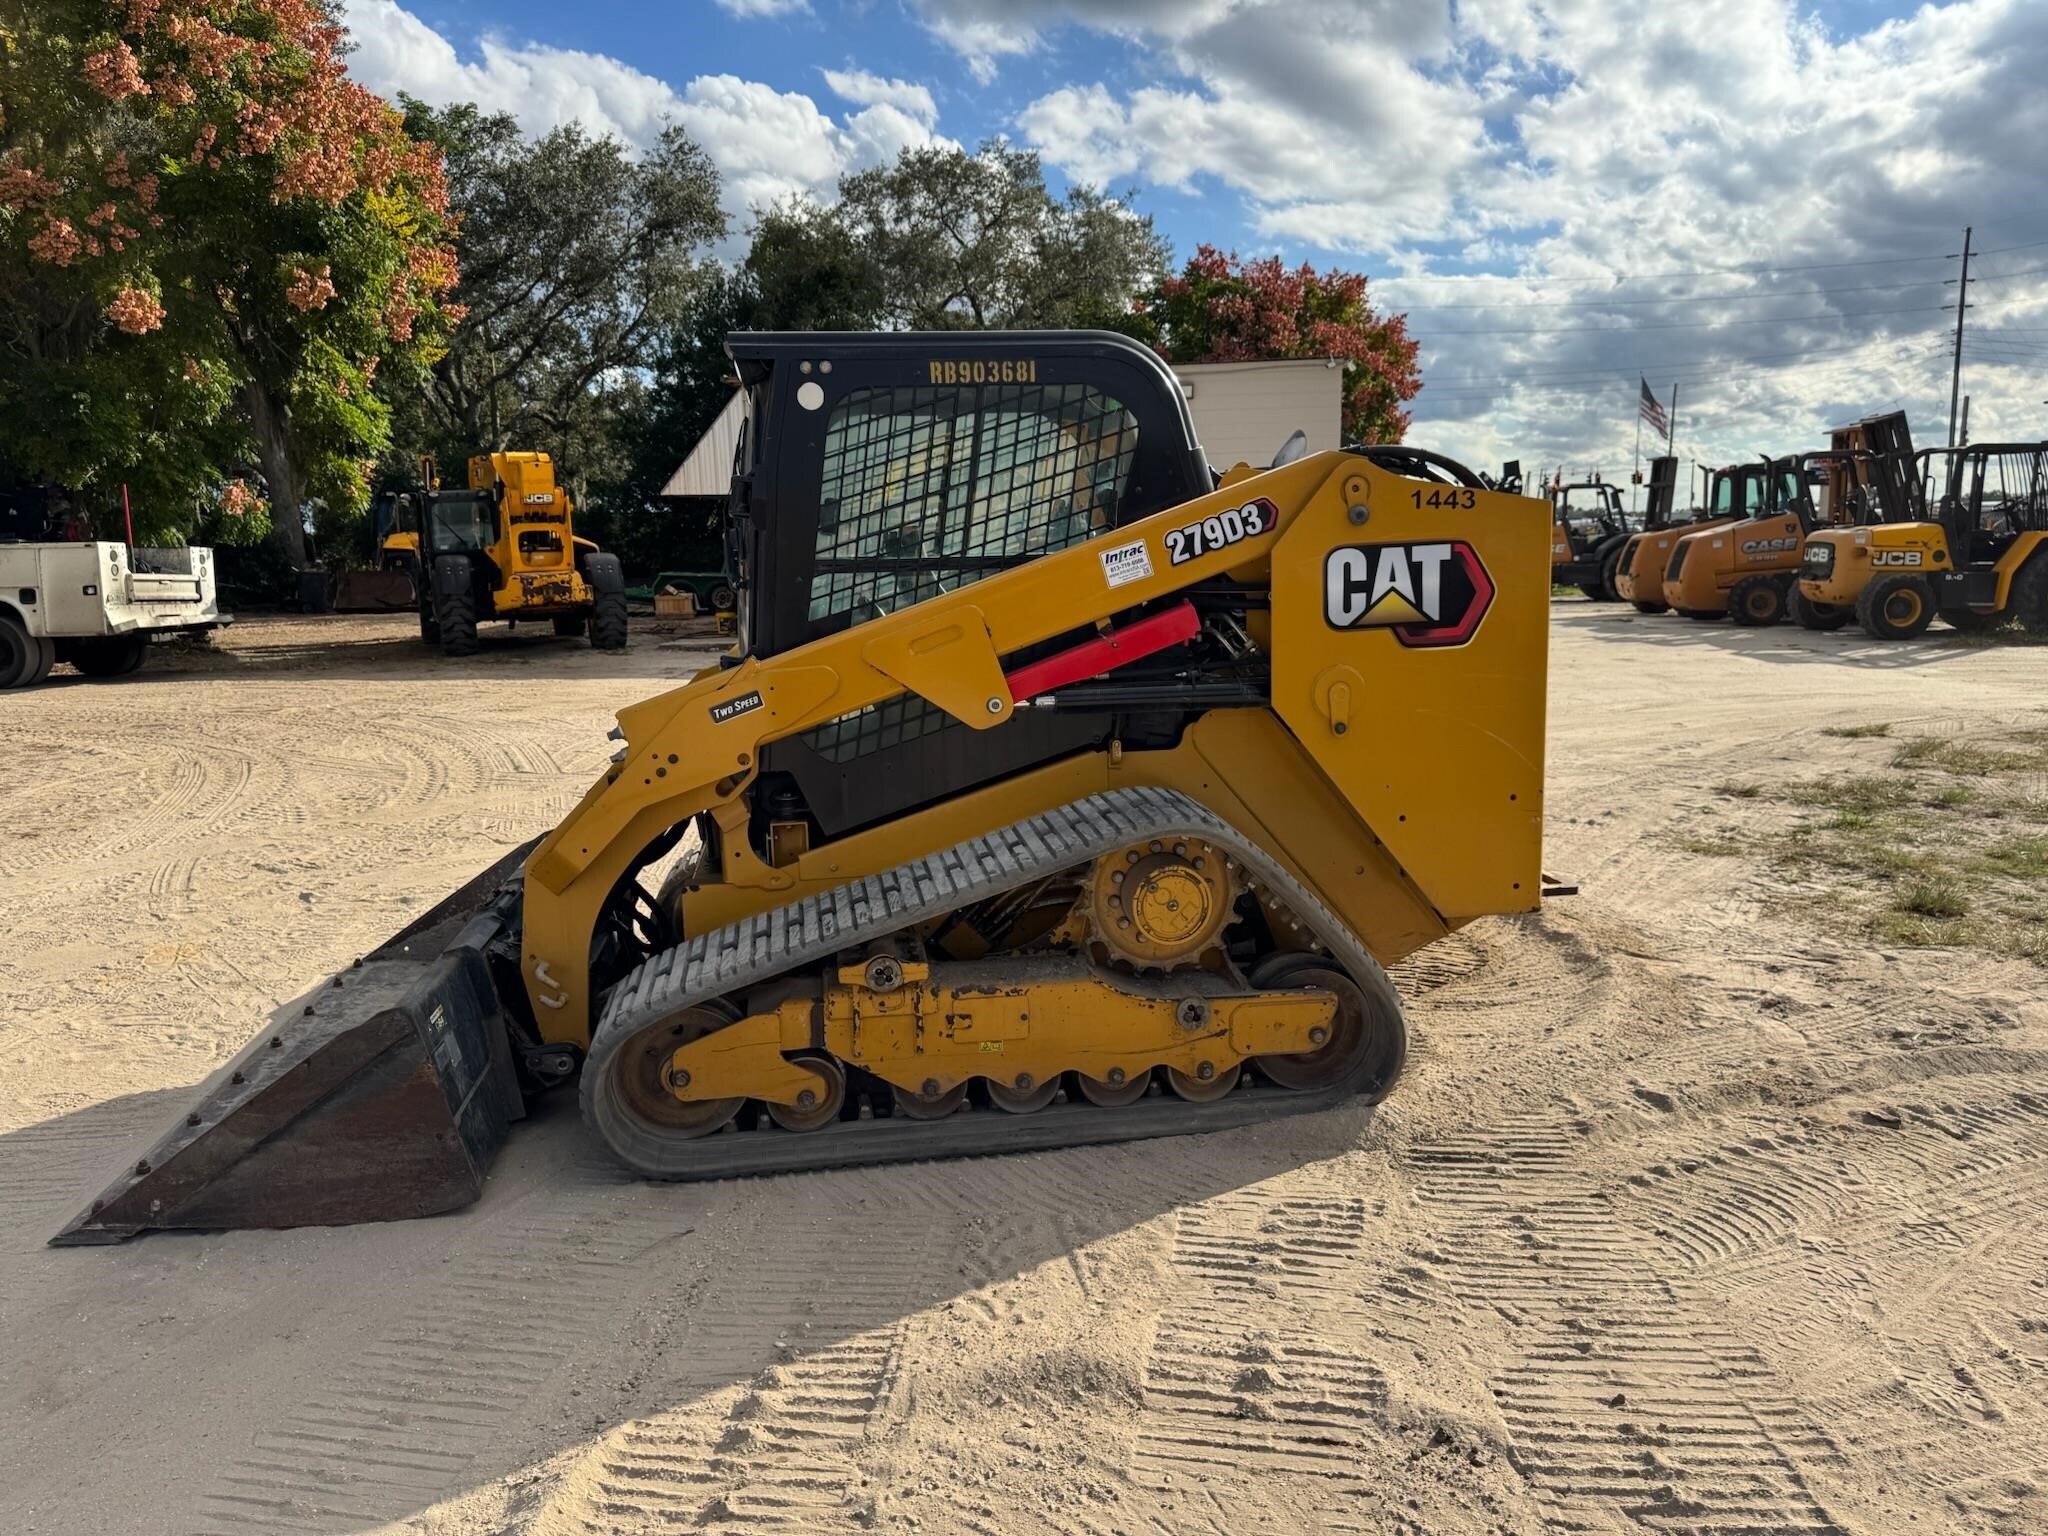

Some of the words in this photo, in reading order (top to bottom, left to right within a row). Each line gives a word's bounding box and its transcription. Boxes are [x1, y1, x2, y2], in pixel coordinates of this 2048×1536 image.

[929, 360, 1036, 384] RB903681
[526, 493, 553, 503] JCB
[1411, 489, 1476, 509] 1443
[1165, 503, 1263, 565] 279D3
[1105, 544, 1144, 565] Intrac
[1742, 537, 1797, 553] CASE
[1803, 547, 1829, 562] JCB
[1872, 551, 1922, 566] JCB
[1327, 543, 1452, 627] CAT
